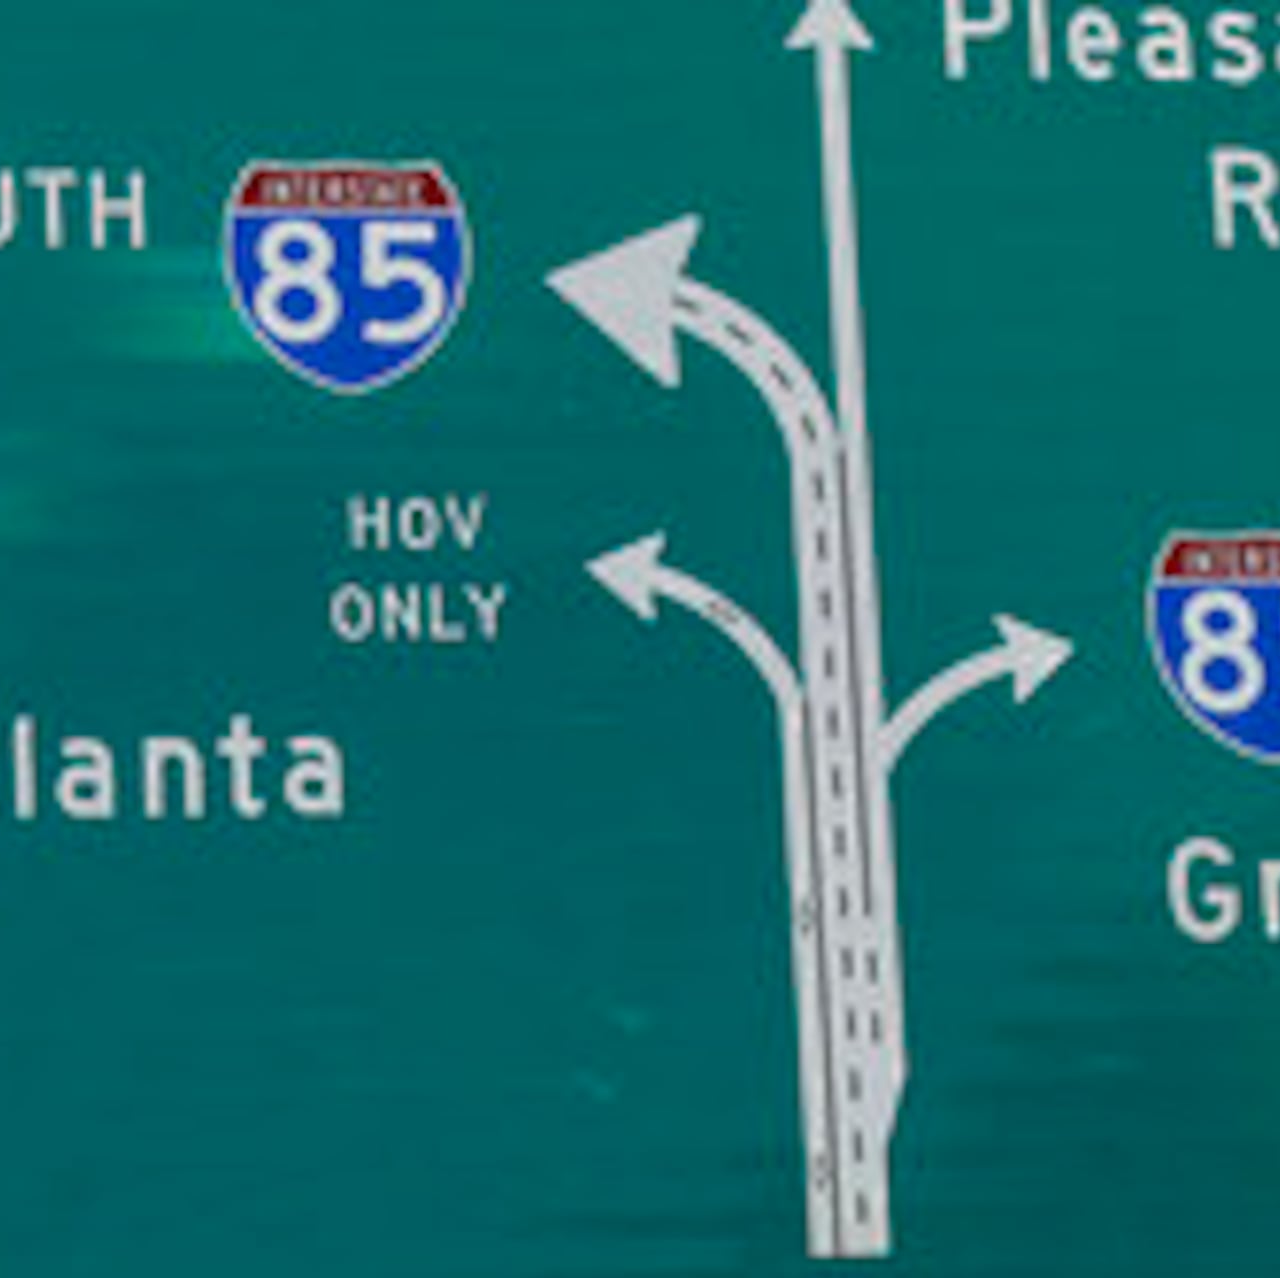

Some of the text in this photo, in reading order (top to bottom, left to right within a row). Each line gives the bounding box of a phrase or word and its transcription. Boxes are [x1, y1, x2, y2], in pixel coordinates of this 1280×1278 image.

[259, 174, 426, 204] INTERSTATE
[252, 219, 447, 343] 85
[348, 496, 486, 550] HOV
[328, 582, 507, 642] ONLY
